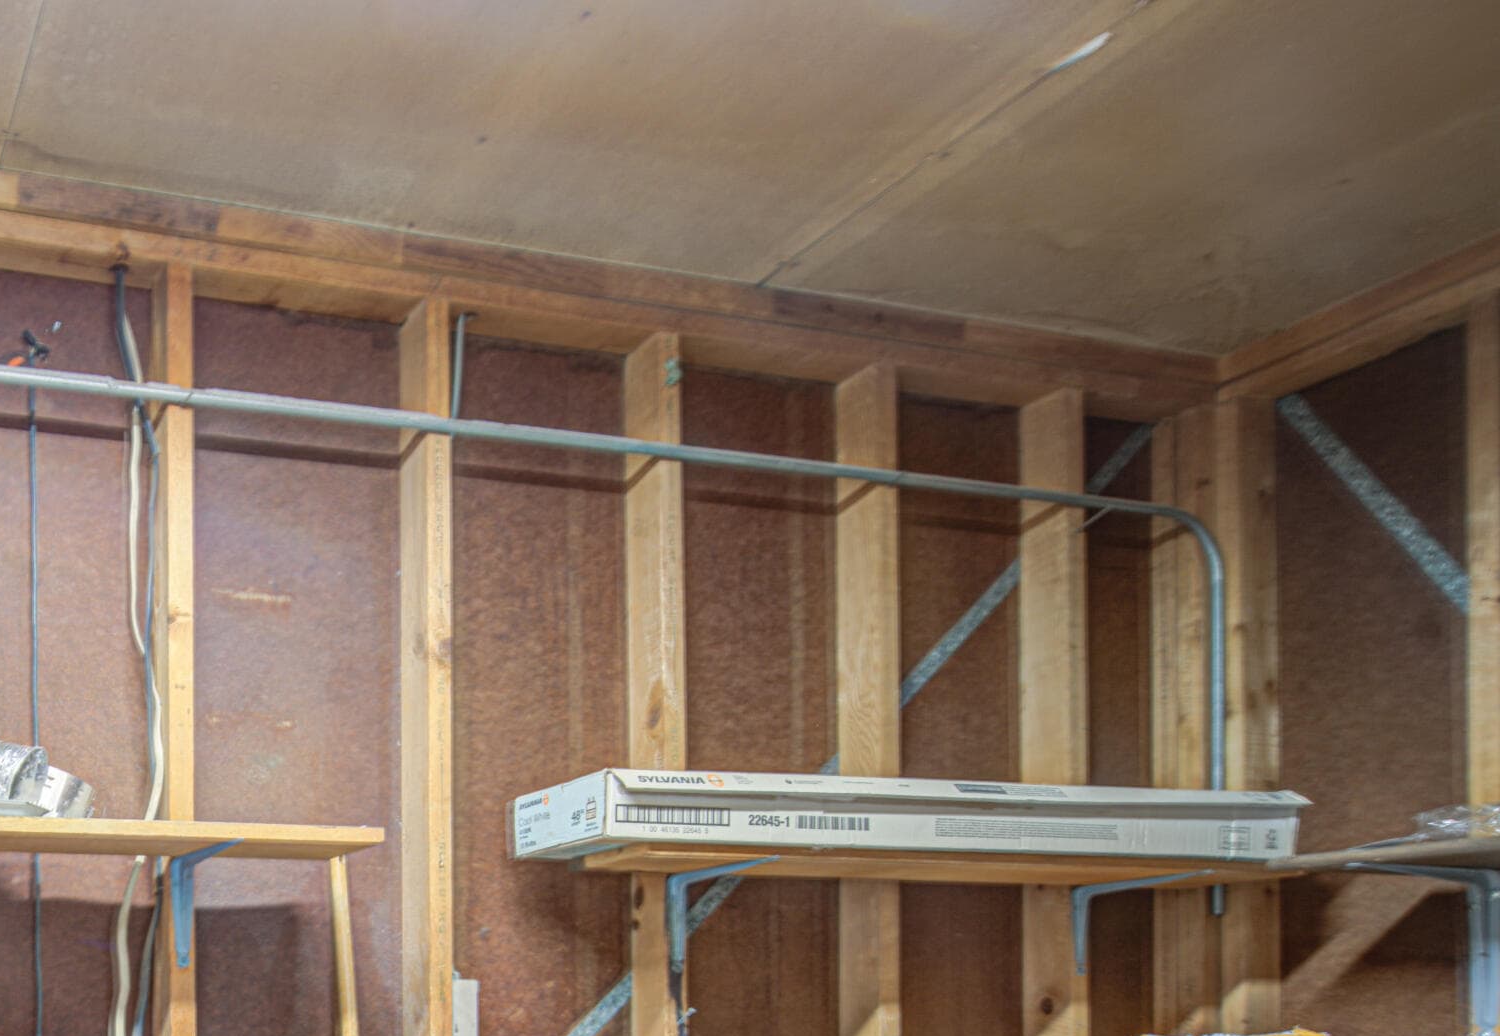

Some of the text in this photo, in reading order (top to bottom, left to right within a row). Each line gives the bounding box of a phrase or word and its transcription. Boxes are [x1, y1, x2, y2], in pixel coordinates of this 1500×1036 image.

[637, 775, 705, 785] SYLVANIA
[519, 798, 542, 811] SYLVANIA
[748, 815, 791, 828] 22645-1
